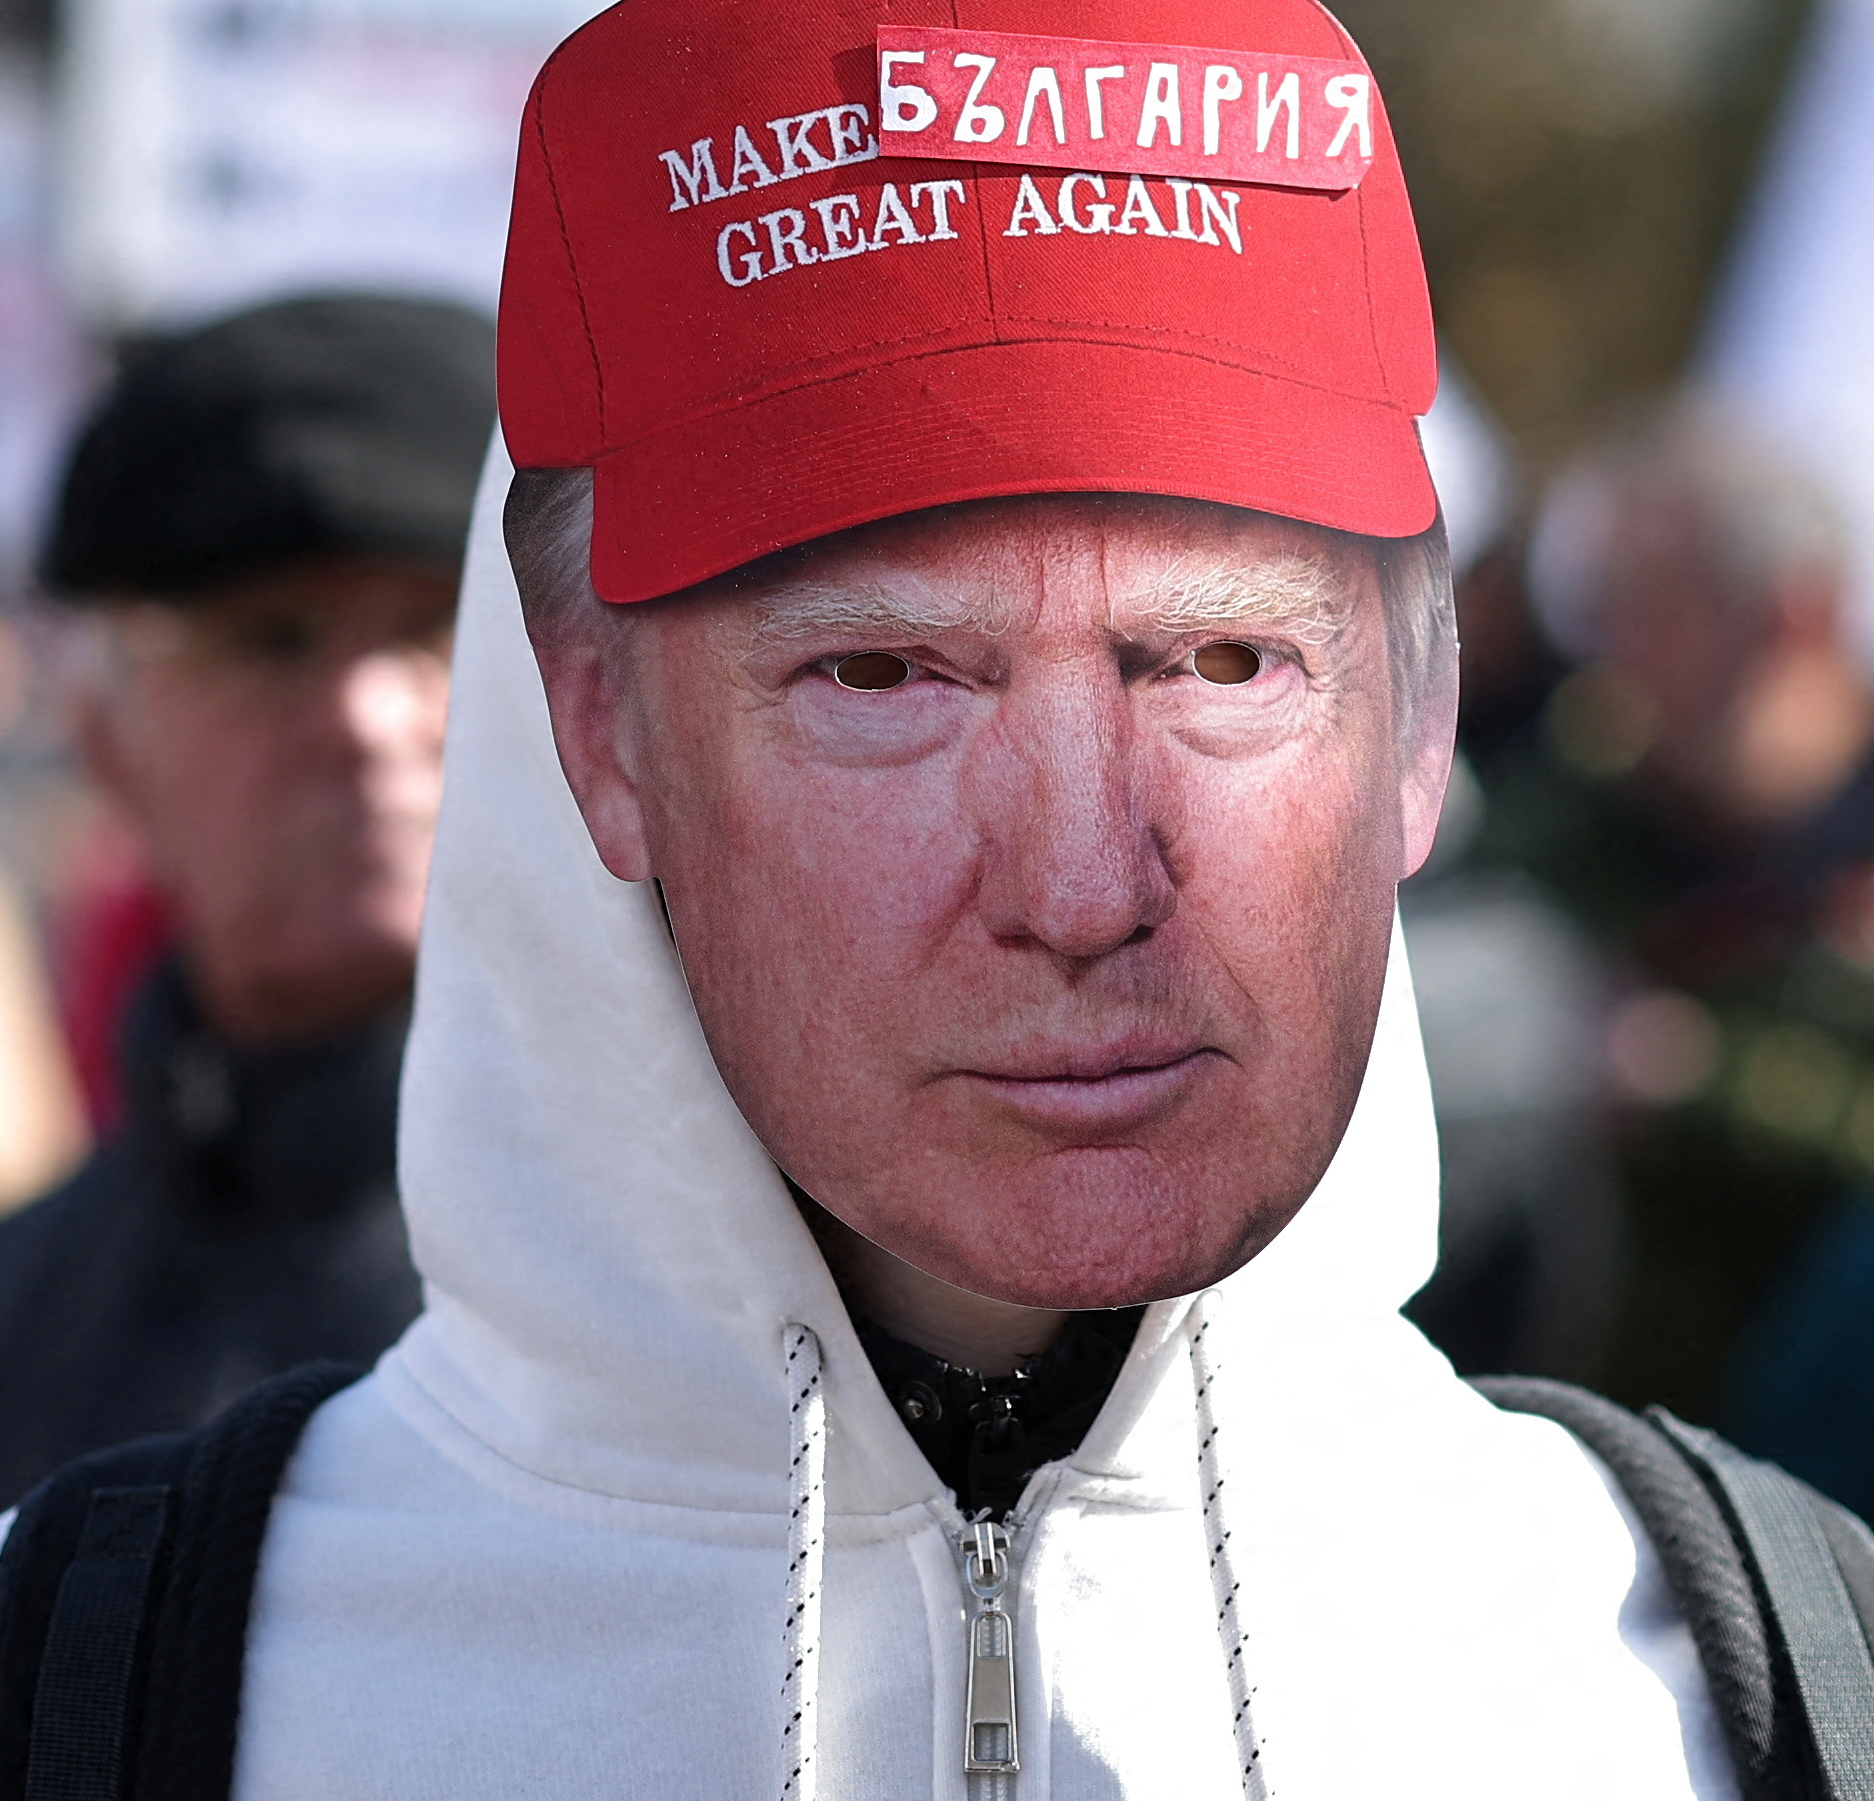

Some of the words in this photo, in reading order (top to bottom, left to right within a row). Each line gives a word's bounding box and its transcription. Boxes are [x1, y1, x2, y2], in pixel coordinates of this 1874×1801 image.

[660, 104, 878, 211] MAKE
[879, 50, 1373, 159] БЪЛГАРИЯ
[717, 180, 965, 288] GREAT
[1002, 173, 1243, 255] AGAIN
